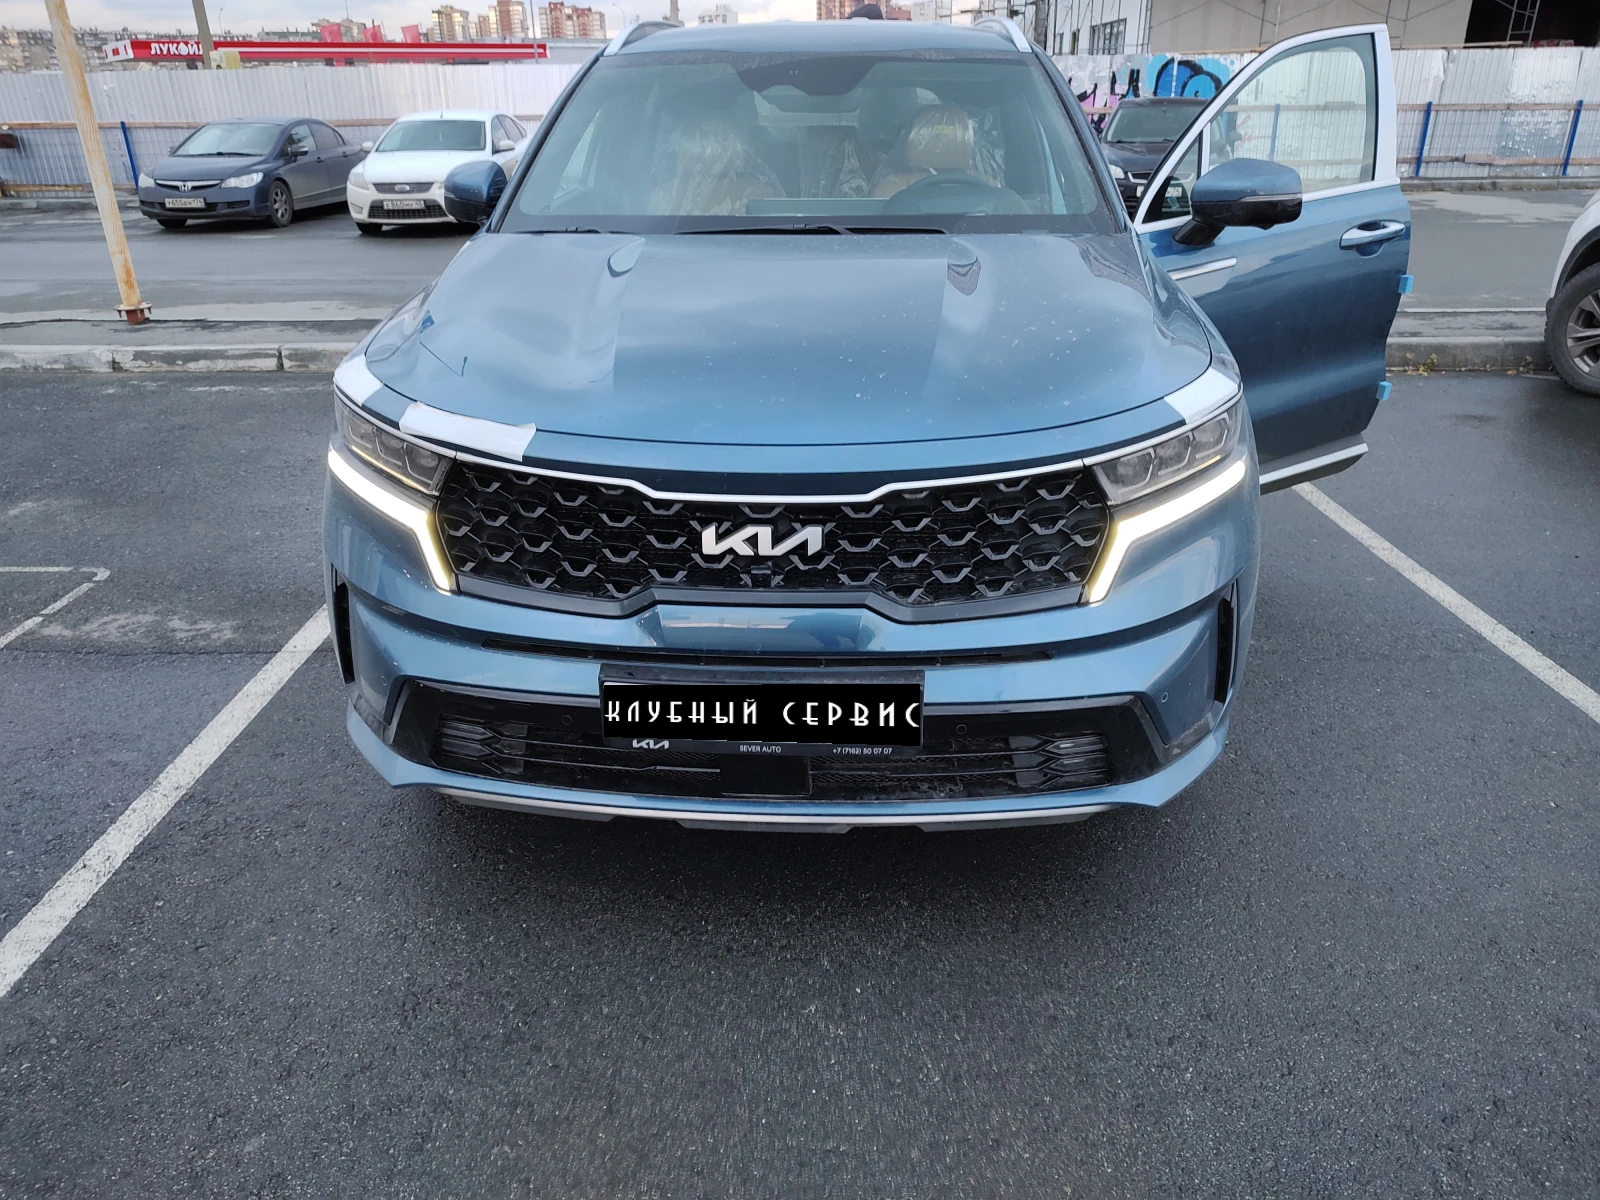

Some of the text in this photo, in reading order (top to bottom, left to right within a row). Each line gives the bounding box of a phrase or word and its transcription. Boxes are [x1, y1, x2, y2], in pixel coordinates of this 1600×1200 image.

[701, 524, 823, 556] KIA
[633, 738, 670, 749] KIA
[762, 745, 782, 753] AUTO
[832, 747, 841, 755] +7
[873, 747, 882, 755] 07
[883, 747, 893, 755] 07
